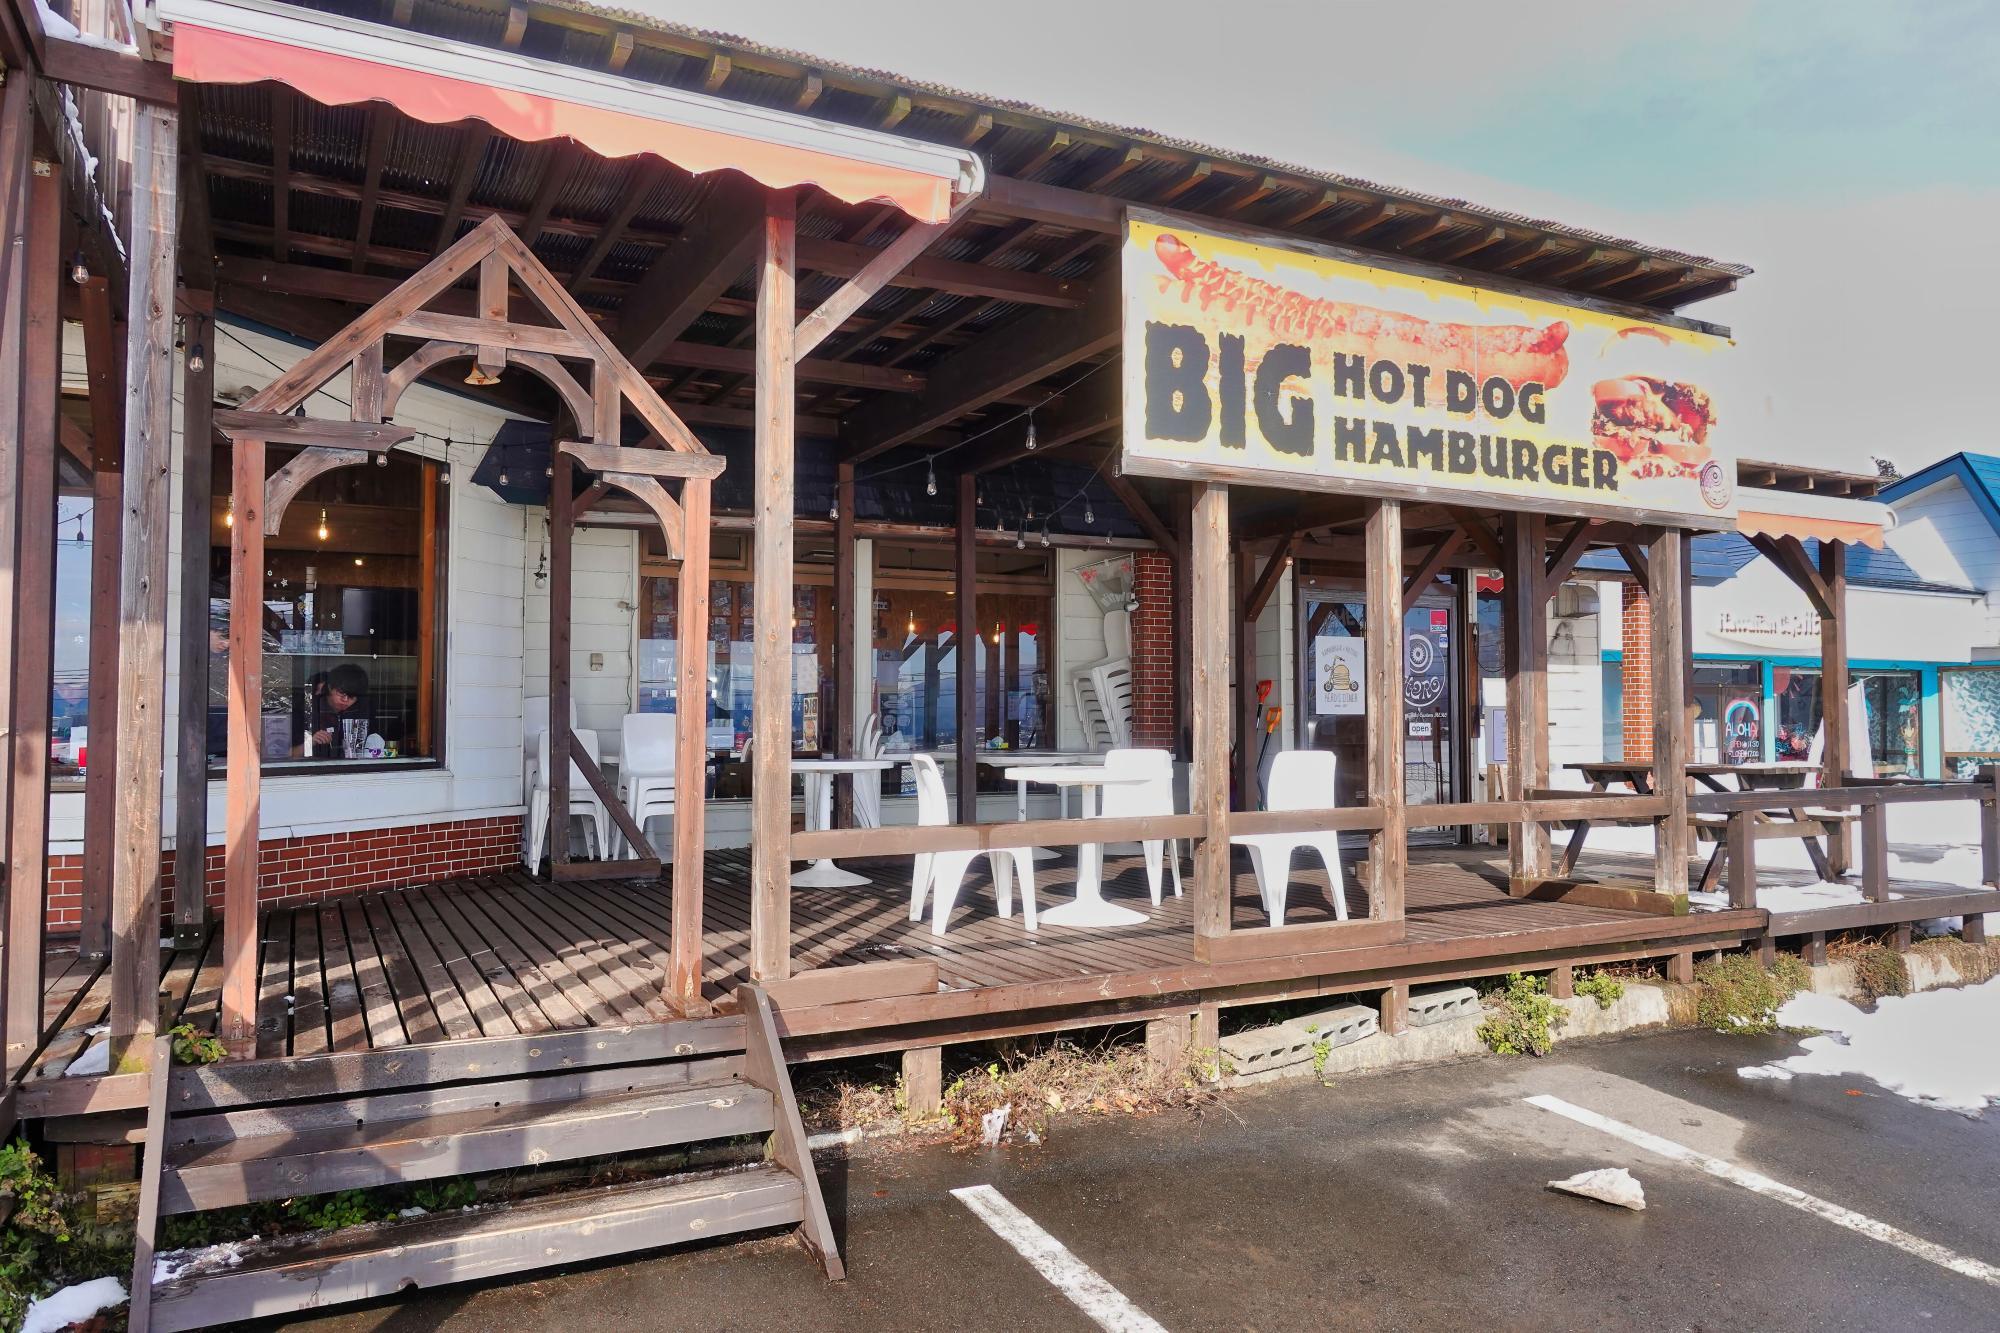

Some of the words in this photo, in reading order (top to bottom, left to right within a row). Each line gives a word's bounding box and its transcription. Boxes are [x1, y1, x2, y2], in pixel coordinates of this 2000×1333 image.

[1144, 320, 1315, 456] BIG
[1333, 352, 1430, 409] HOT
[1446, 369, 1546, 424] DOG
[1333, 416, 1619, 491] HAMBURGER
[1412, 726, 1429, 735] open
[1725, 722, 1757, 737] ALOHA
